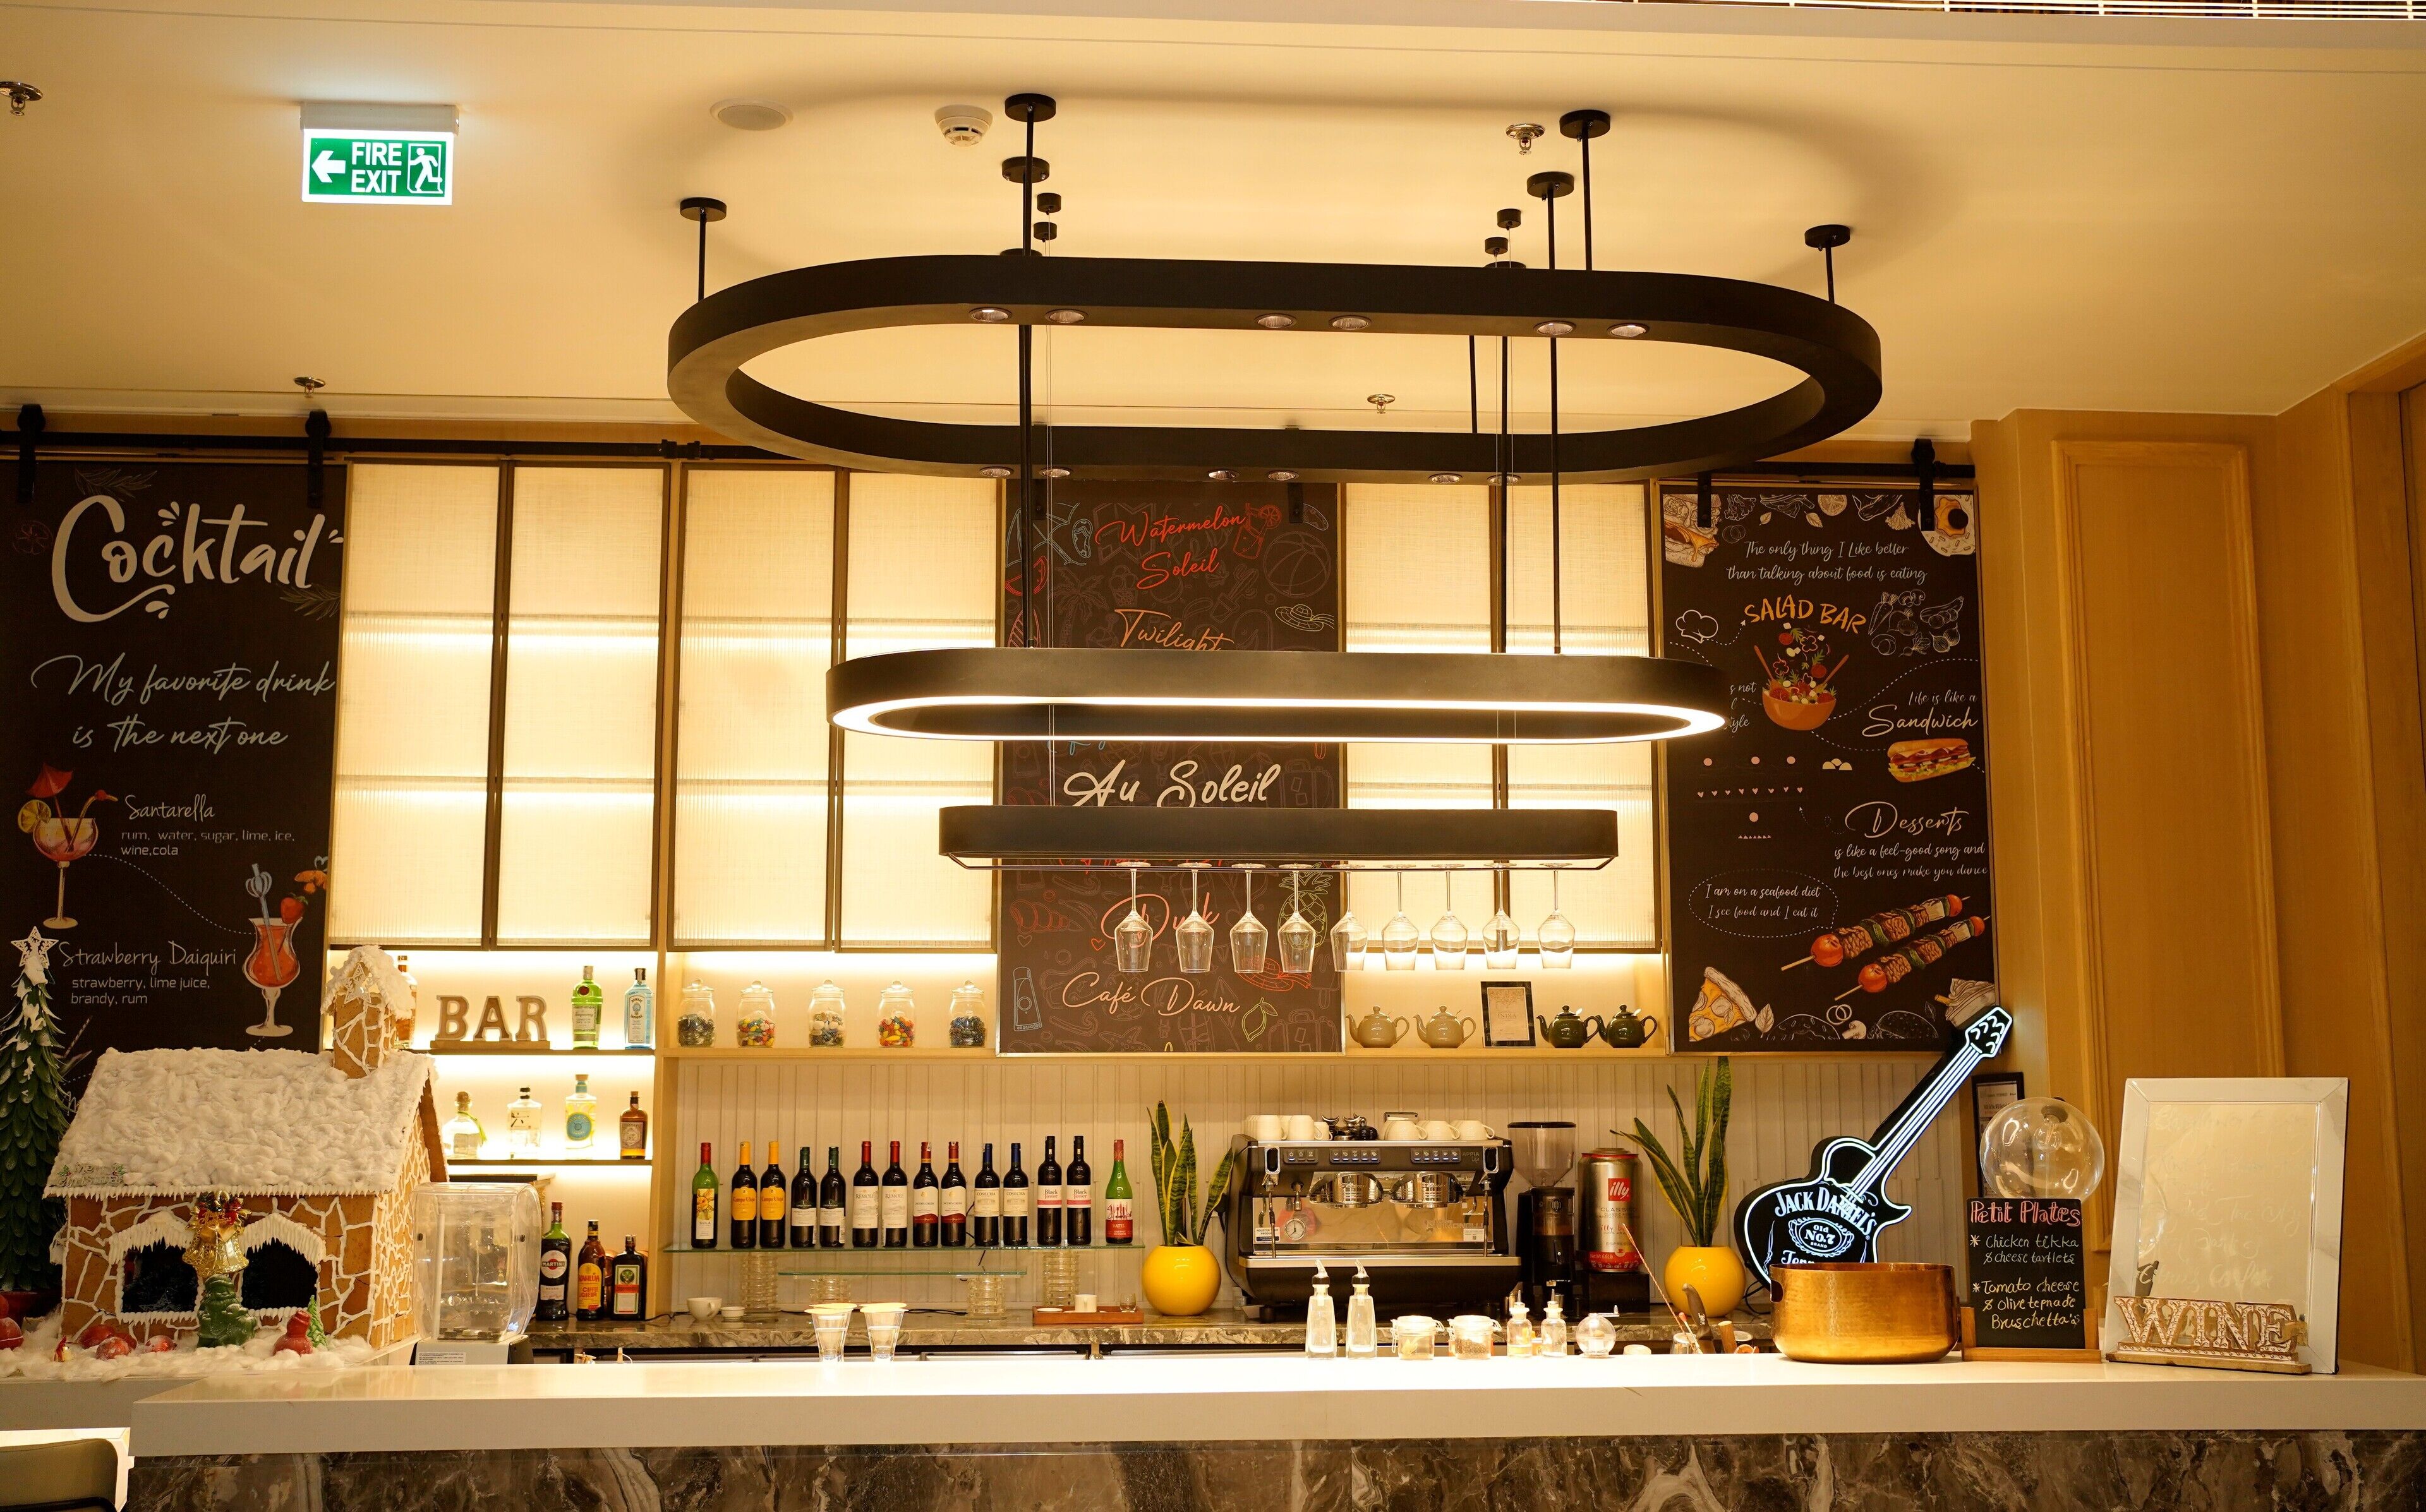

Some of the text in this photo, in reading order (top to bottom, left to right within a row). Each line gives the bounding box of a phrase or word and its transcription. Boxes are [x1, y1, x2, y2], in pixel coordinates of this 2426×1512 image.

[351, 142, 402, 166] FIRE
[351, 169, 402, 193] EXIT
[1095, 505, 1246, 547] Watermelon
[52, 495, 327, 623] Cocktail
[1744, 541, 1765, 558] The
[1768, 540, 1799, 561] only
[1801, 541, 1834, 561] thing
[1838, 541, 1845, 558] I
[1875, 541, 1909, 555] better
[1137, 548, 1221, 590] Soleil
[1726, 565, 1928, 586] than talking about food is eating
[1744, 594, 1867, 634] SALAD BAR
[31, 652, 336, 706] My favorite drink
[1931, 692, 1942, 705] is
[1944, 689, 1966, 703] like
[1969, 695, 1977, 703] a
[1861, 704, 1979, 738] Sandwich
[72, 725, 93, 748] is
[170, 716, 246, 755] next
[237, 729, 289, 745] one
[1063, 759, 1281, 808] Au Soleil
[124, 793, 216, 822] Santarella
[1844, 801, 1970, 839] Desserts
[121, 832, 150, 841] rum,
[200, 832, 238, 844] sugar,
[242, 829, 272, 841] lime,
[275, 831, 295, 841] ice,
[121, 844, 179, 856] wine,cola
[1834, 847, 1844, 860] is
[1846, 843, 1867, 858] like
[1880, 843, 1933, 862] feel-good
[1934, 846, 1961, 861] song
[1964, 842, 1986, 855] and
[1833, 864, 1988, 882] the best ones make you dance
[1705, 884, 1822, 899] I am on a seafood diet
[1707, 904, 1819, 920] I see food and I eat it
[59, 940, 236, 976] Strawberry Daiquiri
[72, 977, 210, 992] strawberry, lime juice,
[1062, 971, 1241, 1016] Café Dawn
[71, 992, 148, 1007] brandy, rum
[435, 994, 548, 1042] BAR
[1609, 1181, 1629, 1200] illy
[1774, 1187, 1878, 1236] JACK DANIEL'S
[1970, 1200, 2080, 1227] Petit Plates
[1813, 1223, 1829, 1233] Old
[1986, 1233, 2079, 1249] Chicken tikka
[1995, 1251, 2028, 1264] cheese
[2031, 1251, 2075, 1264] tartlets
[1981, 1276, 2080, 1295] Tomato cheese
[1997, 1296, 2025, 1311] olive
[2028, 1293, 2076, 1311] tepnade
[2114, 1296, 2296, 1353] WINE
